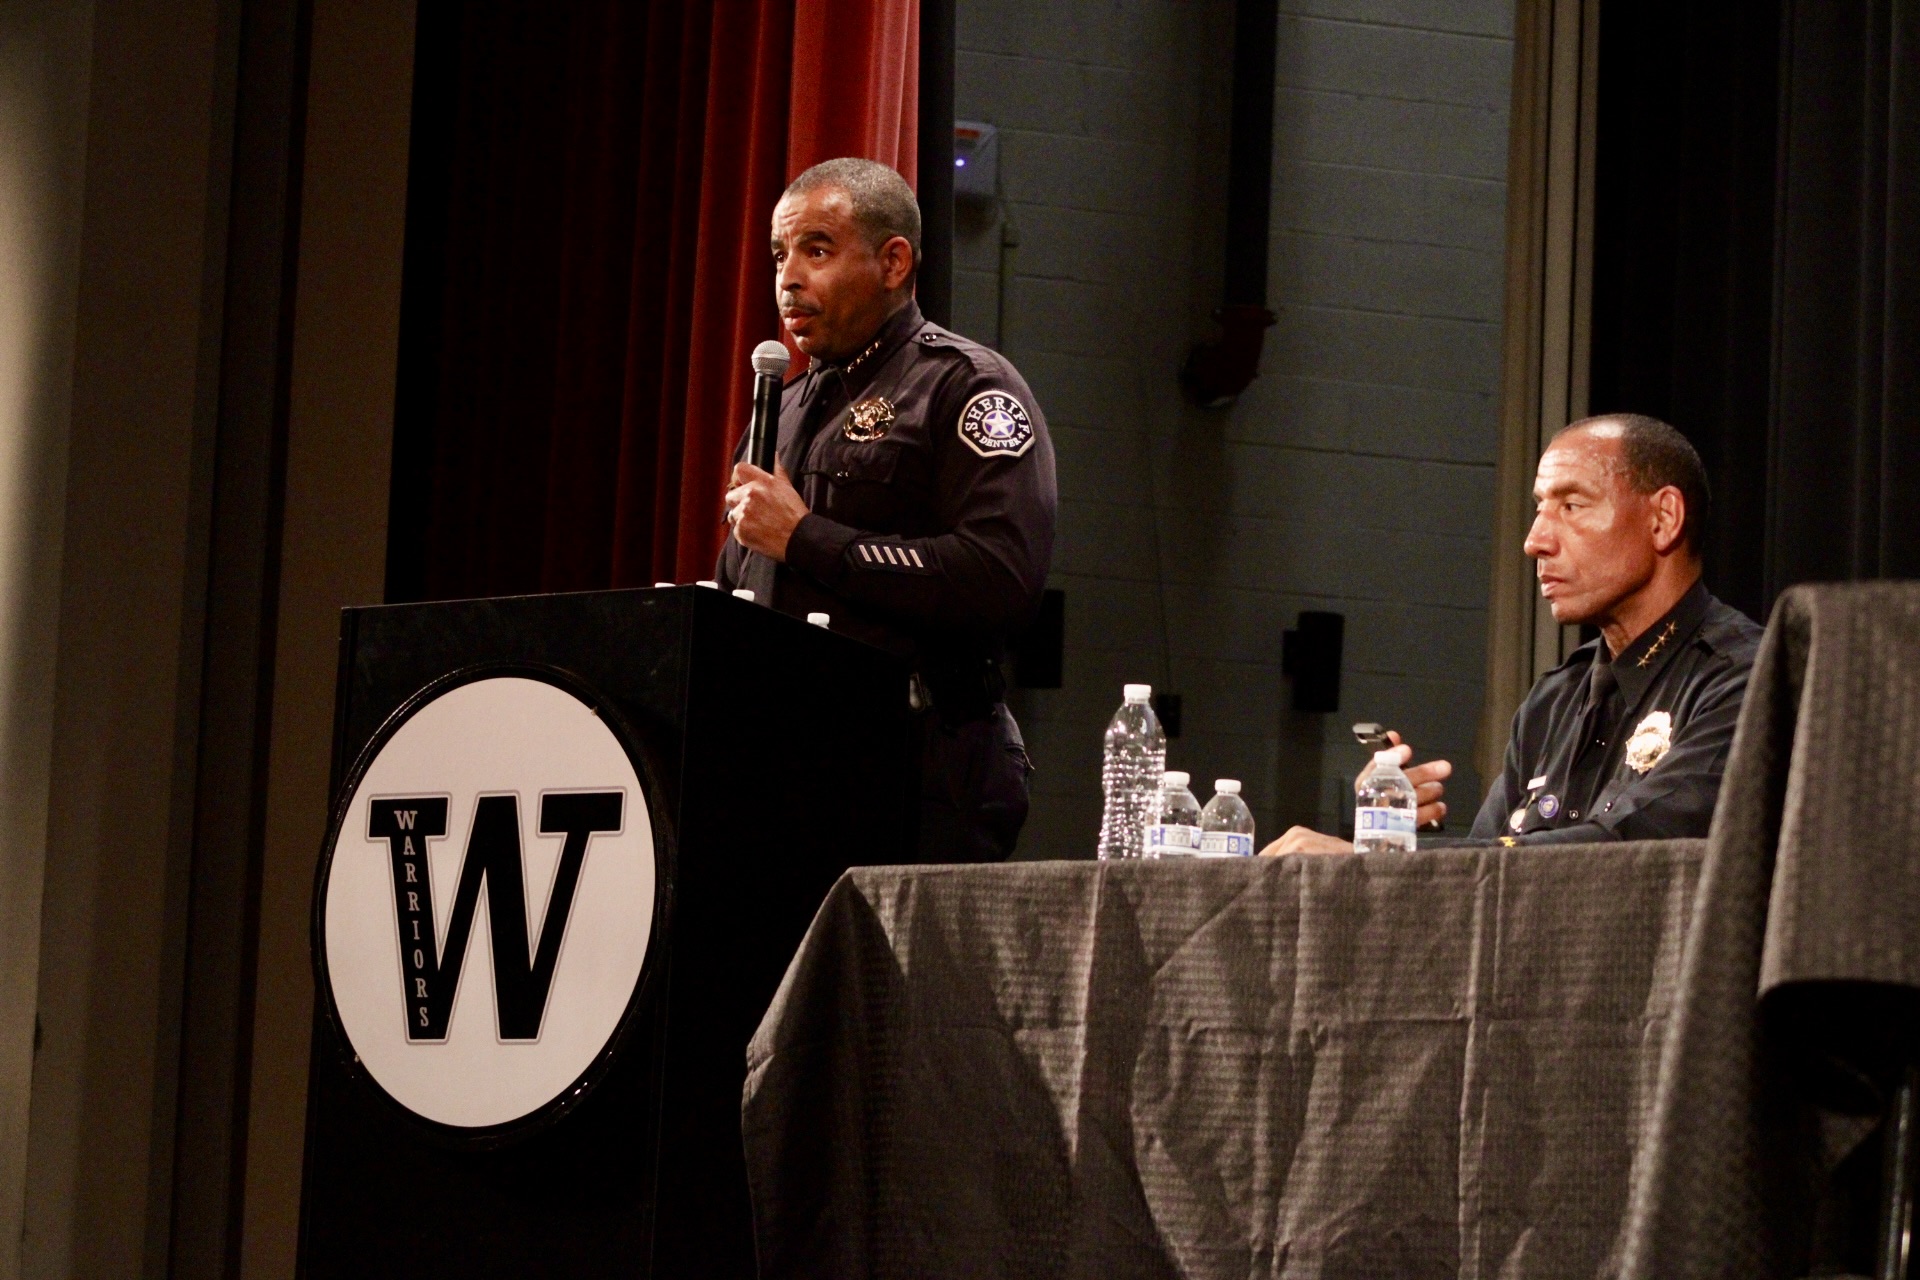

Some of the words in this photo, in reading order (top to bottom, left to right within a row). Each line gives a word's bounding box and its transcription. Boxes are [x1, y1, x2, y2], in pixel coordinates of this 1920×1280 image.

[965, 397, 1030, 434] SHERIFF
[979, 436, 1021, 448] DENVER
[367, 788, 626, 1043] W
[394, 810, 429, 1027] WARRIORS
